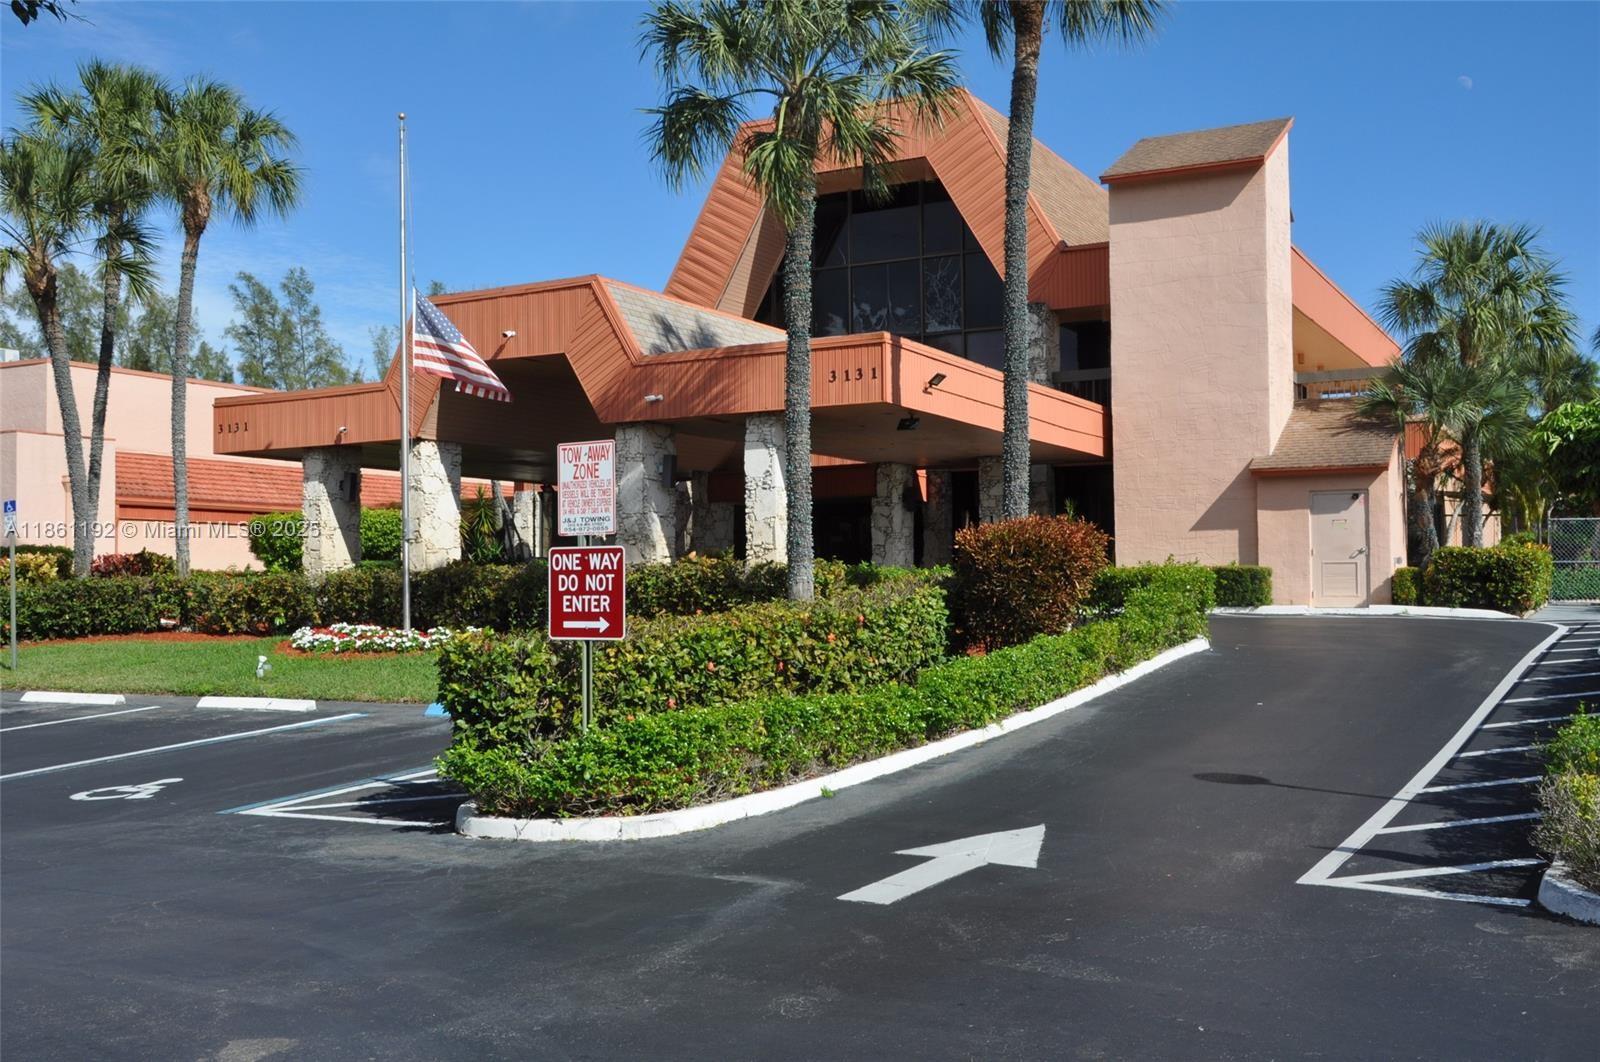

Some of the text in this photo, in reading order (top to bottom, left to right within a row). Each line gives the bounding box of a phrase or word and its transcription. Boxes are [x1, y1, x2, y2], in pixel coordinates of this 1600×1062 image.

[828, 367, 877, 383] 3131
[218, 422, 249, 434] 3131
[561, 444, 611, 464] TOW AWAY
[573, 462, 599, 480] ZONE
[580, 515, 611, 523] TOWING
[552, 552, 621, 571] ONE WAY
[558, 573, 615, 591] DO NOT
[562, 595, 610, 612] ENTER
